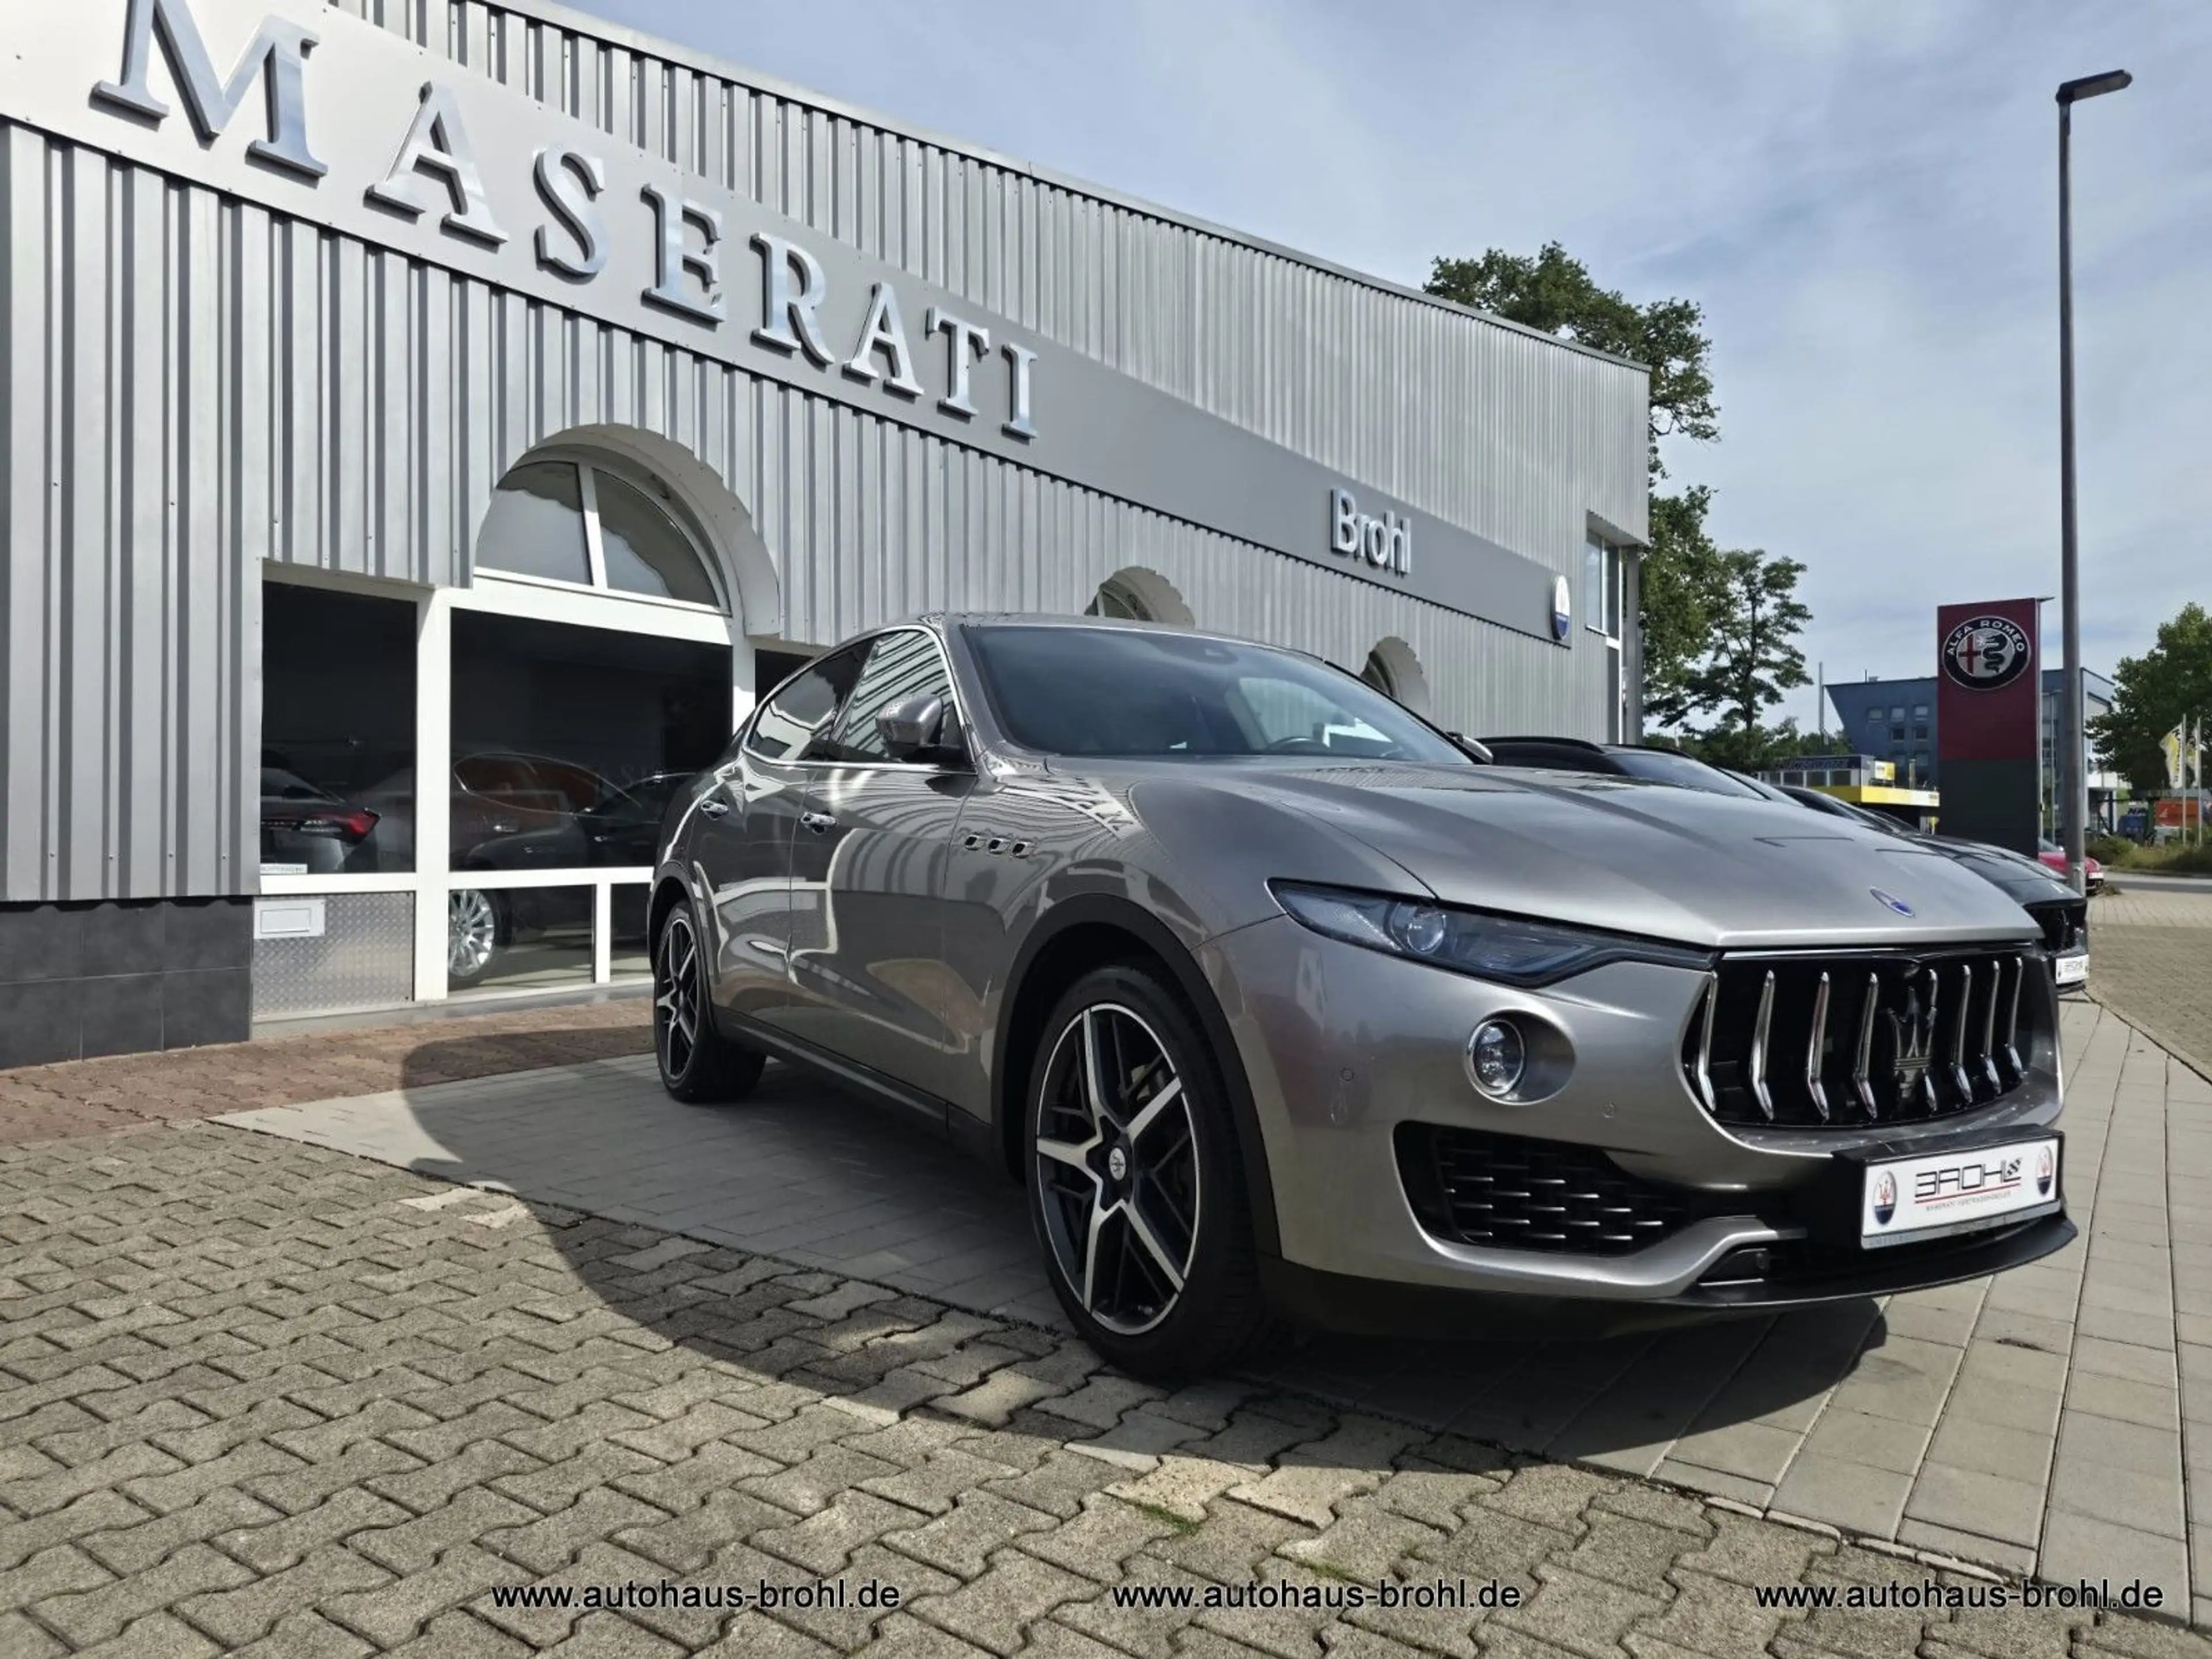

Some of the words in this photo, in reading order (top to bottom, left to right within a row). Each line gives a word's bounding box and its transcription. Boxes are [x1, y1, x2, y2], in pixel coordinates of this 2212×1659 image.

[92, 0, 1039, 439] MASERATI
[1331, 487, 1411, 574] Brohl
[1946, 626, 1974, 656] ALFA
[1980, 620, 2025, 652] ROMEO
